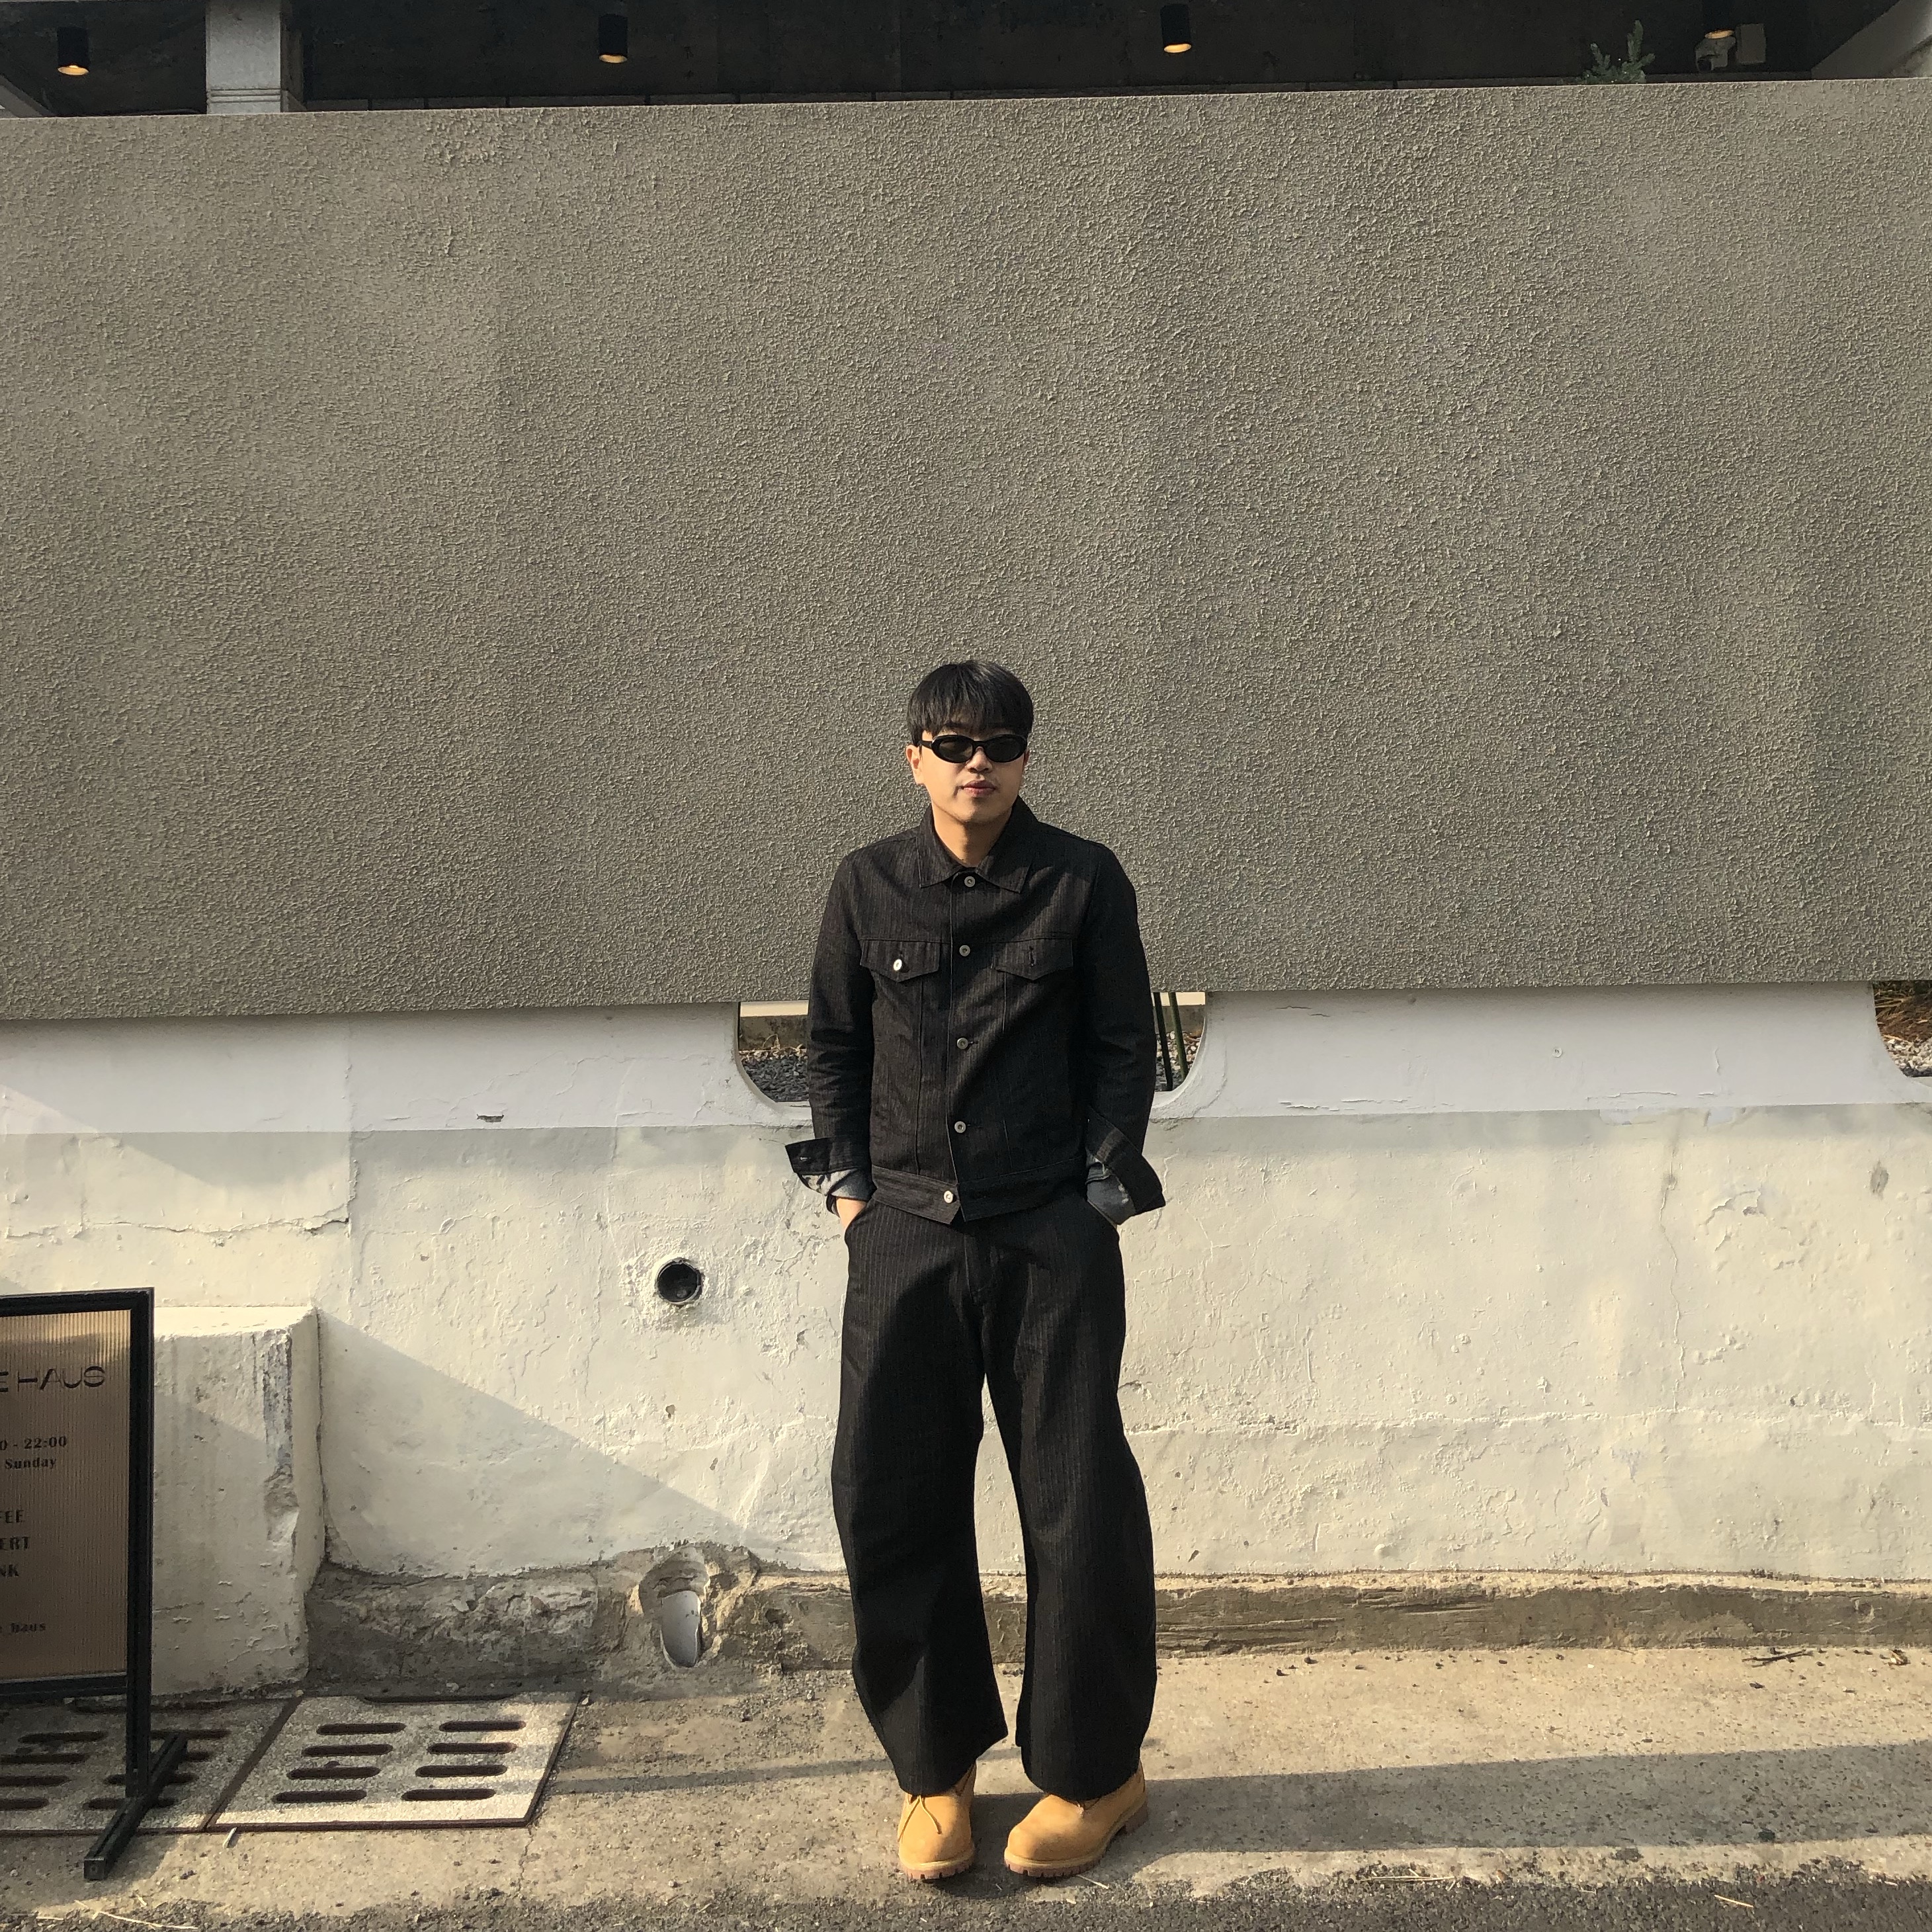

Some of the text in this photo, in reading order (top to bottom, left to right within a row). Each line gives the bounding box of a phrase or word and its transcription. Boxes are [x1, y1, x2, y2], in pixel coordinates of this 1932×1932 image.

[17, 1366, 105, 1392] HAUS
[24, 1436, 67, 1449] 22:00
[5, 1457, 56, 1469] Sunday
